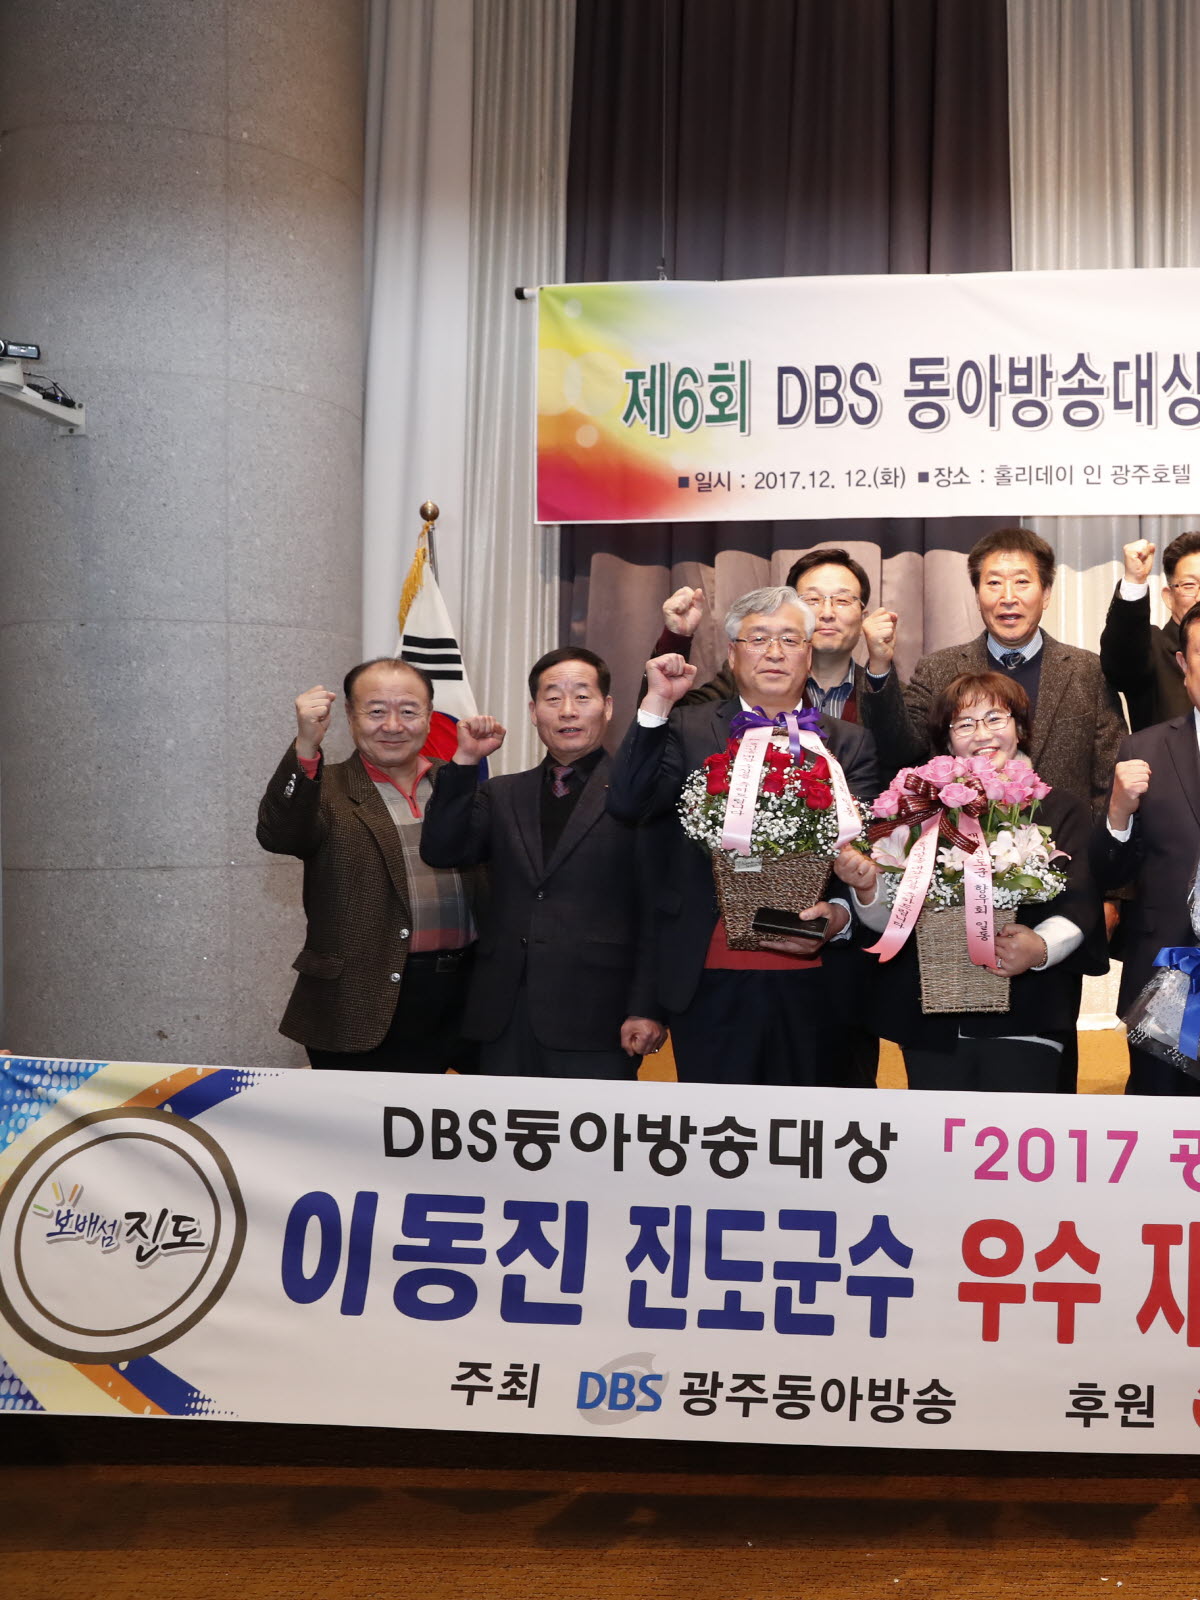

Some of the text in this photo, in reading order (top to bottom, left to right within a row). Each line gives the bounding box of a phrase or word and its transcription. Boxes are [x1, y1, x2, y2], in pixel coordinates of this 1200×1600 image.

[621, 360, 751, 438] 제6회
[777, 362, 882, 428] DBS
[694, 471, 731, 491] 일시
[934, 467, 971, 487] 장소
[994, 465, 1073, 486] 홀리데이
[1084, 465, 1101, 484] 인
[1111, 464, 1189, 485] 광주호텔
[383, 1106, 898, 1184] DBS동아방송대상
[46, 1207, 205, 1262] 보배섬 진도
[281, 1191, 588, 1325] 이동진
[626, 1205, 914, 1338] 진도군수
[958, 1219, 1101, 1344] 우수
[451, 1362, 956, 1424] 주최 DBS 광주동아방송
[1065, 1383, 1154, 1428] 후원
